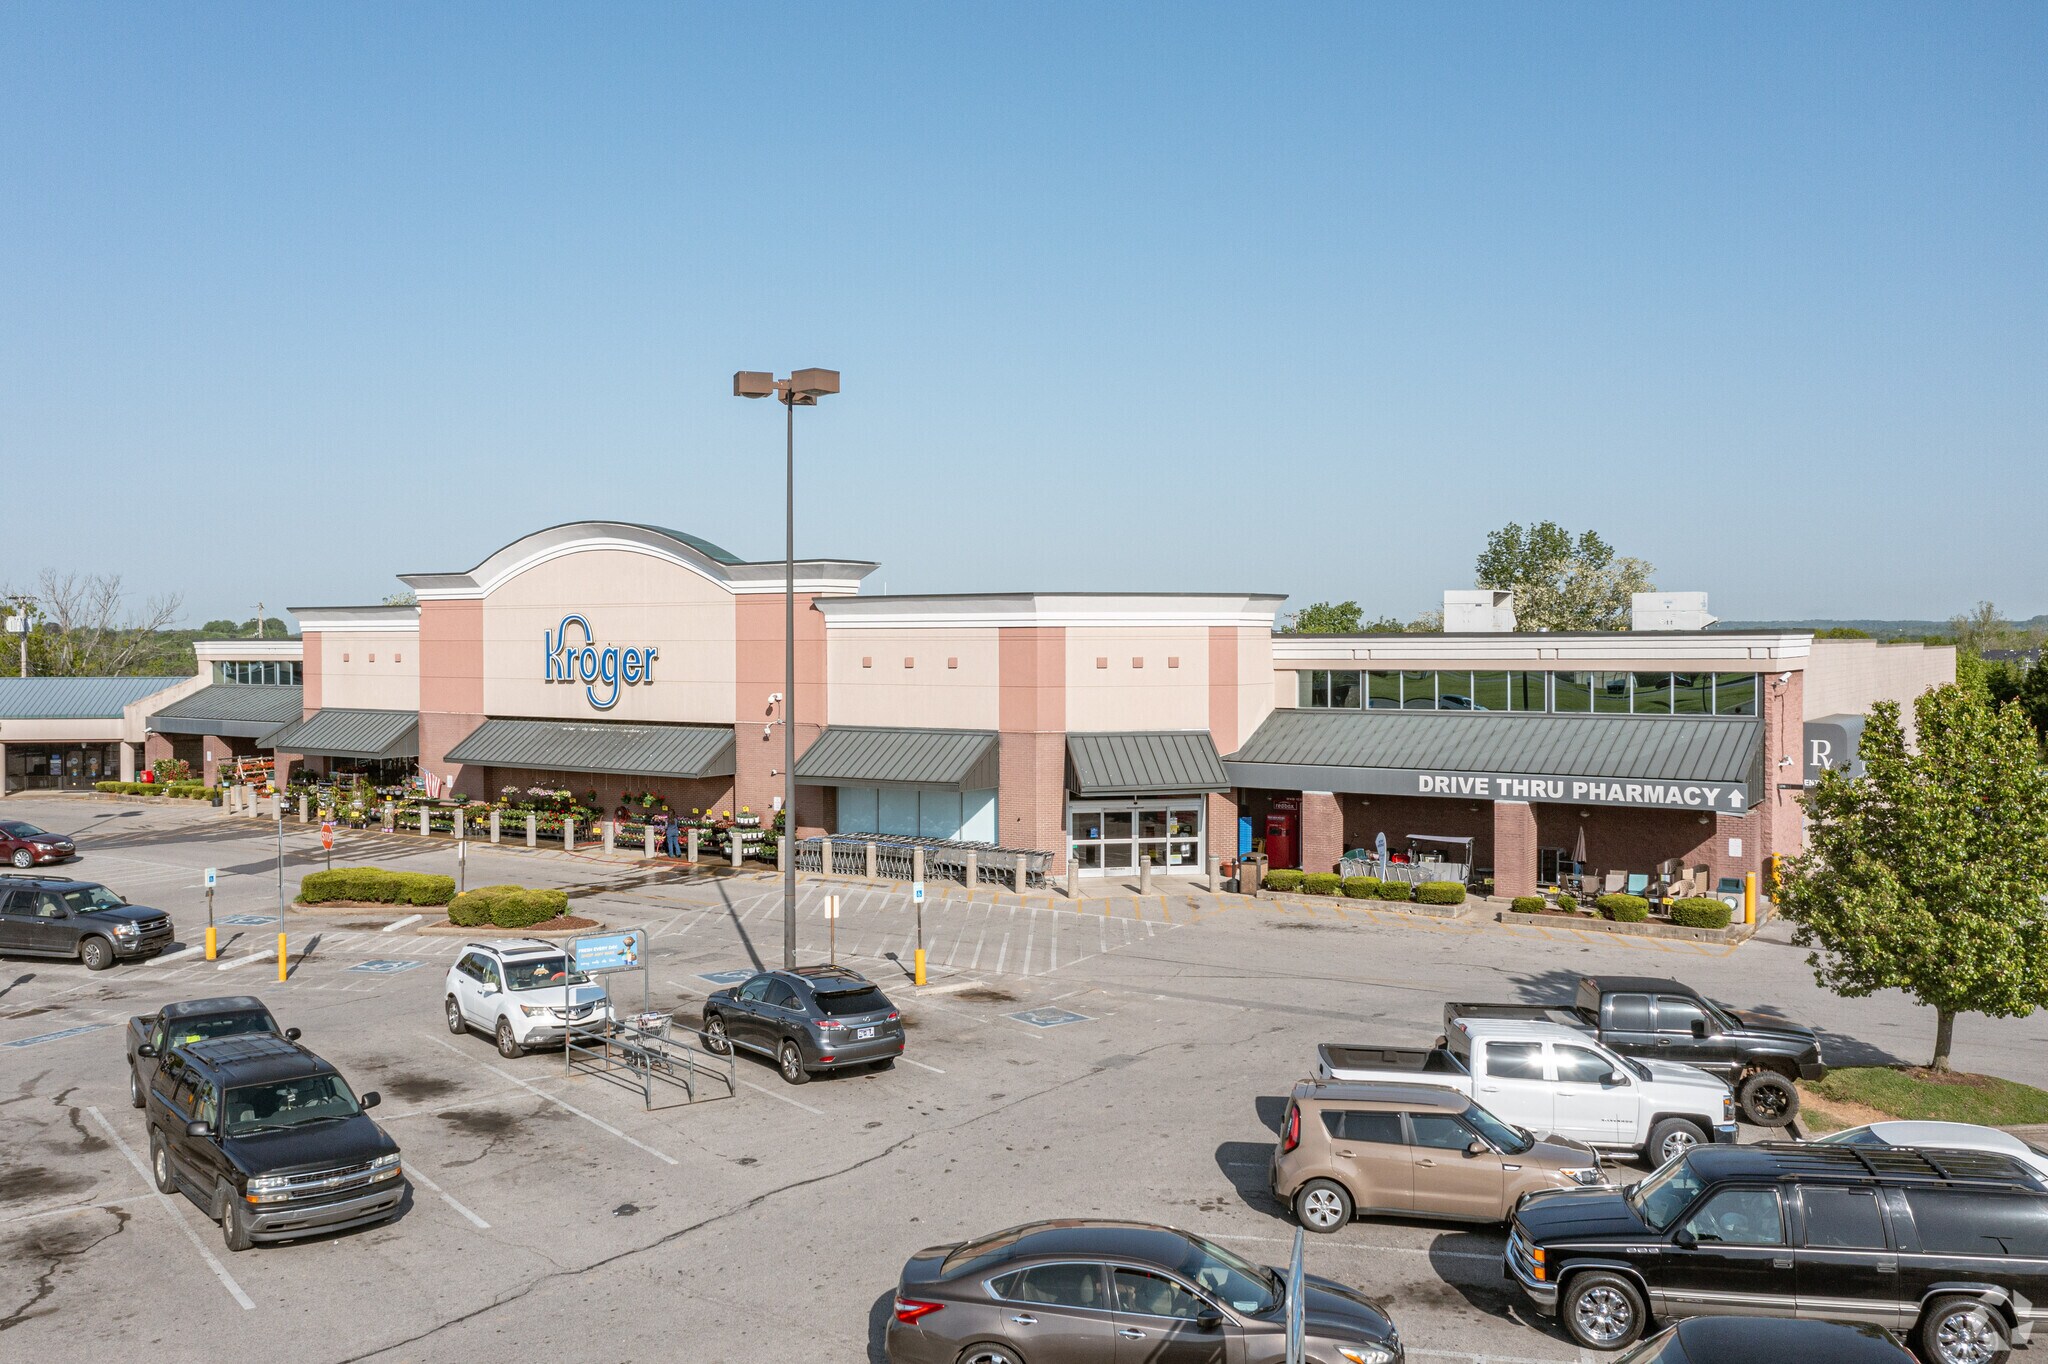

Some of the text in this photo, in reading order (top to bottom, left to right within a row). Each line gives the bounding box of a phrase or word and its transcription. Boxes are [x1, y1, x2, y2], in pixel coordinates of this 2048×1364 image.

[544, 613, 659, 710] Kroger
[1418, 774, 1721, 806] DRIVE THRU PHARMACY
[322, 831, 333, 842] STOP
